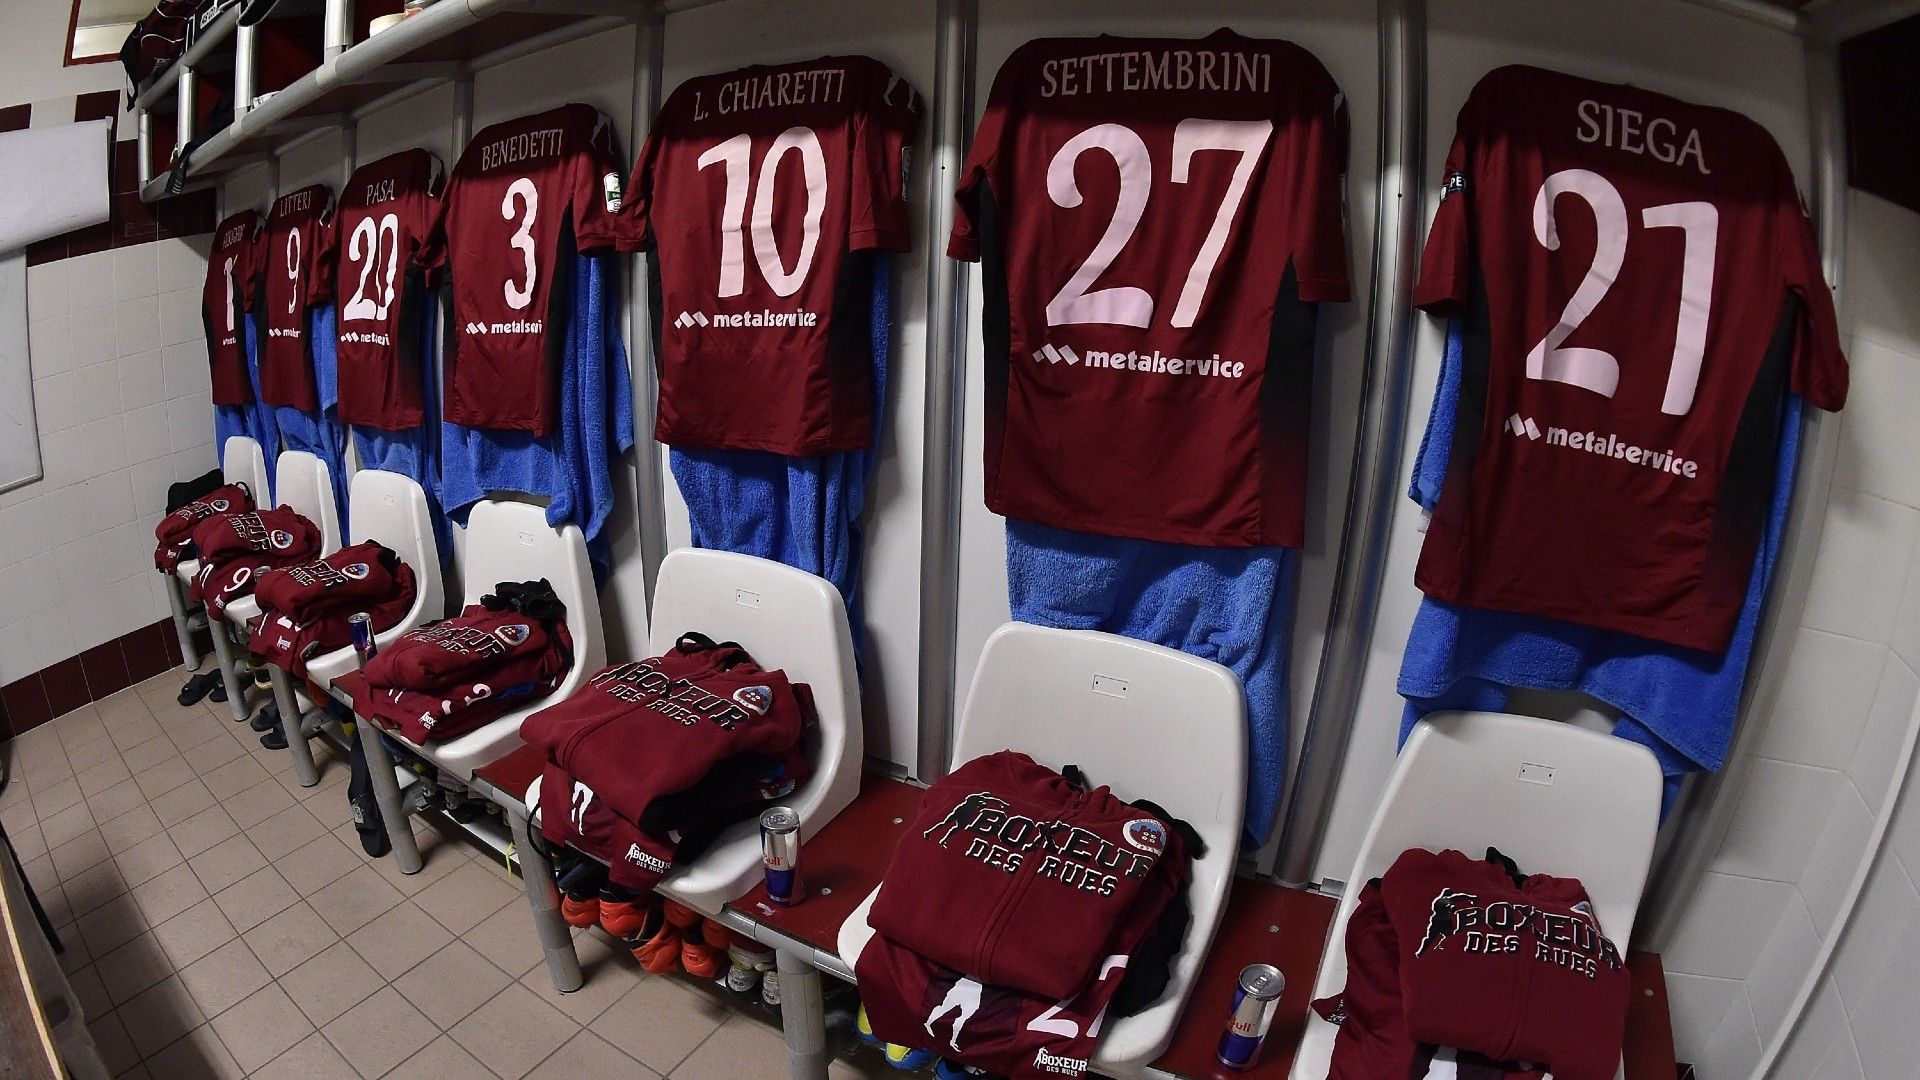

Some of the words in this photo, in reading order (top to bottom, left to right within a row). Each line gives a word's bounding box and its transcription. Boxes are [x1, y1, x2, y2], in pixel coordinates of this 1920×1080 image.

[693, 91, 709, 122] L.
[718, 69, 845, 115] CHIARETTI
[1040, 50, 1271, 97] SETTEMBRINI
[481, 128, 563, 172] BENEDETTI
[1576, 100, 1711, 175] SIEGA
[280, 191, 312, 217] LITTERI
[366, 179, 395, 206] PASA
[697, 126, 828, 297] 10
[501, 177, 538, 309] 3
[1046, 118, 1273, 328] 27
[286, 227, 301, 314] 9
[343, 213, 399, 321] 20
[1526, 168, 1719, 416] 21
[713, 308, 817, 328] metalservice
[1084, 346, 1245, 378] metalservice
[1546, 424, 1698, 478] metalservice
[223, 567, 252, 593] 9
[606, 683, 647, 702] DES
[645, 699, 701, 726] RUES
[617, 663, 750, 734] BOXEUR
[632, 849, 672, 869] BOXEUR
[964, 807, 1153, 879] BOXEUR
[964, 837, 1025, 873] DES
[1037, 854, 1119, 897] RUES
[1453, 901, 1621, 970] BOXEUR
[1463, 931, 1520, 955] DES
[1535, 940, 1597, 979] RUES
[1041, 1053, 1088, 1072] BOXEUR
